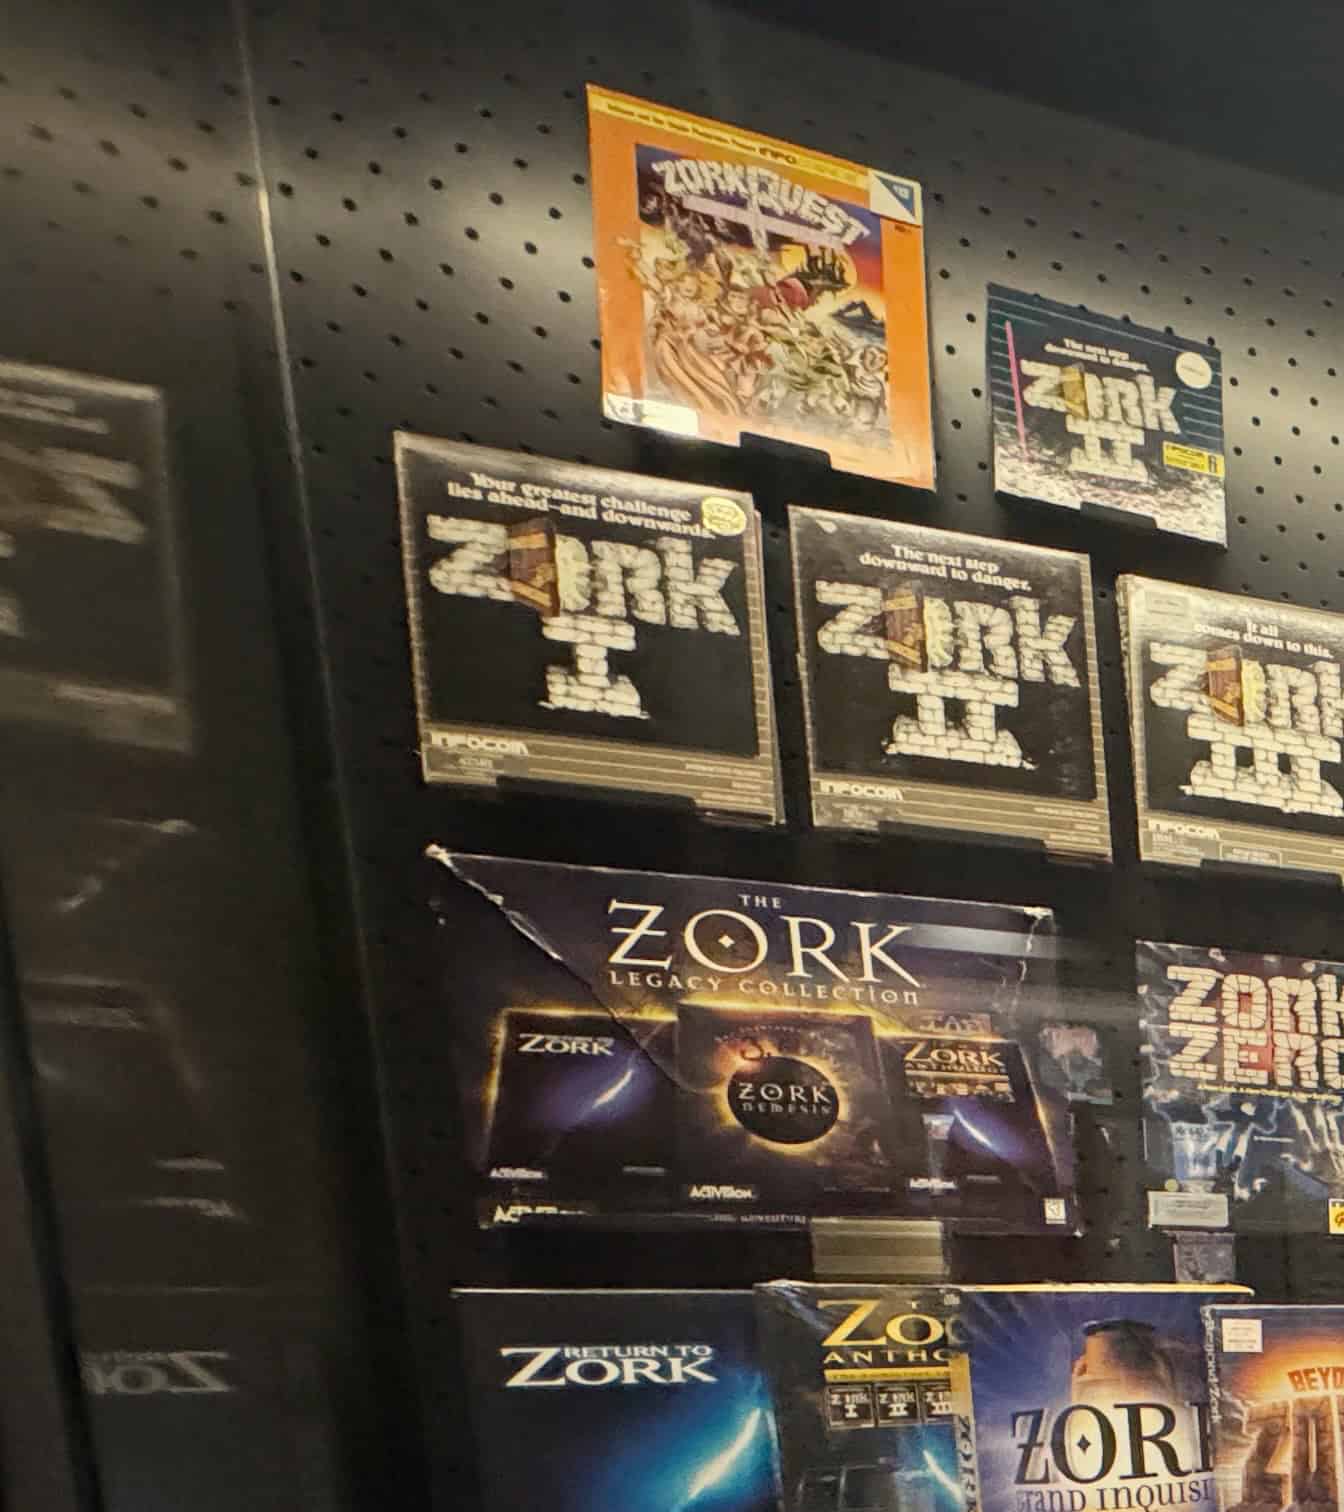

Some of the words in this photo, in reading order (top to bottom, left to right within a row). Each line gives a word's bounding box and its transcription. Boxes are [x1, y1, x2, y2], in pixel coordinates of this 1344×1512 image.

[1019, 359, 1181, 434] ZORK
[1065, 414, 1150, 482] II
[448, 482, 483, 501] lies
[470, 472, 516, 493] Your
[521, 482, 596, 504] greatest
[600, 494, 690, 523] challenge
[426, 514, 741, 637] ZORK
[858, 552, 947, 579] downward
[951, 567, 969, 580] to
[972, 571, 1032, 592] danger.
[891, 544, 924, 561] The
[927, 552, 962, 568] next
[965, 558, 999, 575] step
[815, 580, 1081, 688] ZORK
[1195, 623, 1239, 641] comes
[1243, 630, 1284, 650] down
[1286, 641, 1301, 652] to
[1246, 620, 1258, 633] It
[1259, 622, 1279, 636] all
[538, 615, 651, 720] I
[885, 663, 1039, 771] II
[740, 893, 783, 910] THE
[607, 899, 922, 988] ZORK
[610, 970, 725, 993] LEGACY
[737, 979, 920, 1006] COLLECTION
[518, 1034, 616, 1056] ZORK
[904, 1040, 1005, 1066] ZORK
[738, 1082, 831, 1103] ZORK
[690, 1185, 753, 1200] ACTIVISION
[816, 1299, 962, 1346] ZO
[500, 1347, 718, 1386] ZORK
[564, 1345, 670, 1359] RETURN
[675, 1344, 713, 1357] TO
